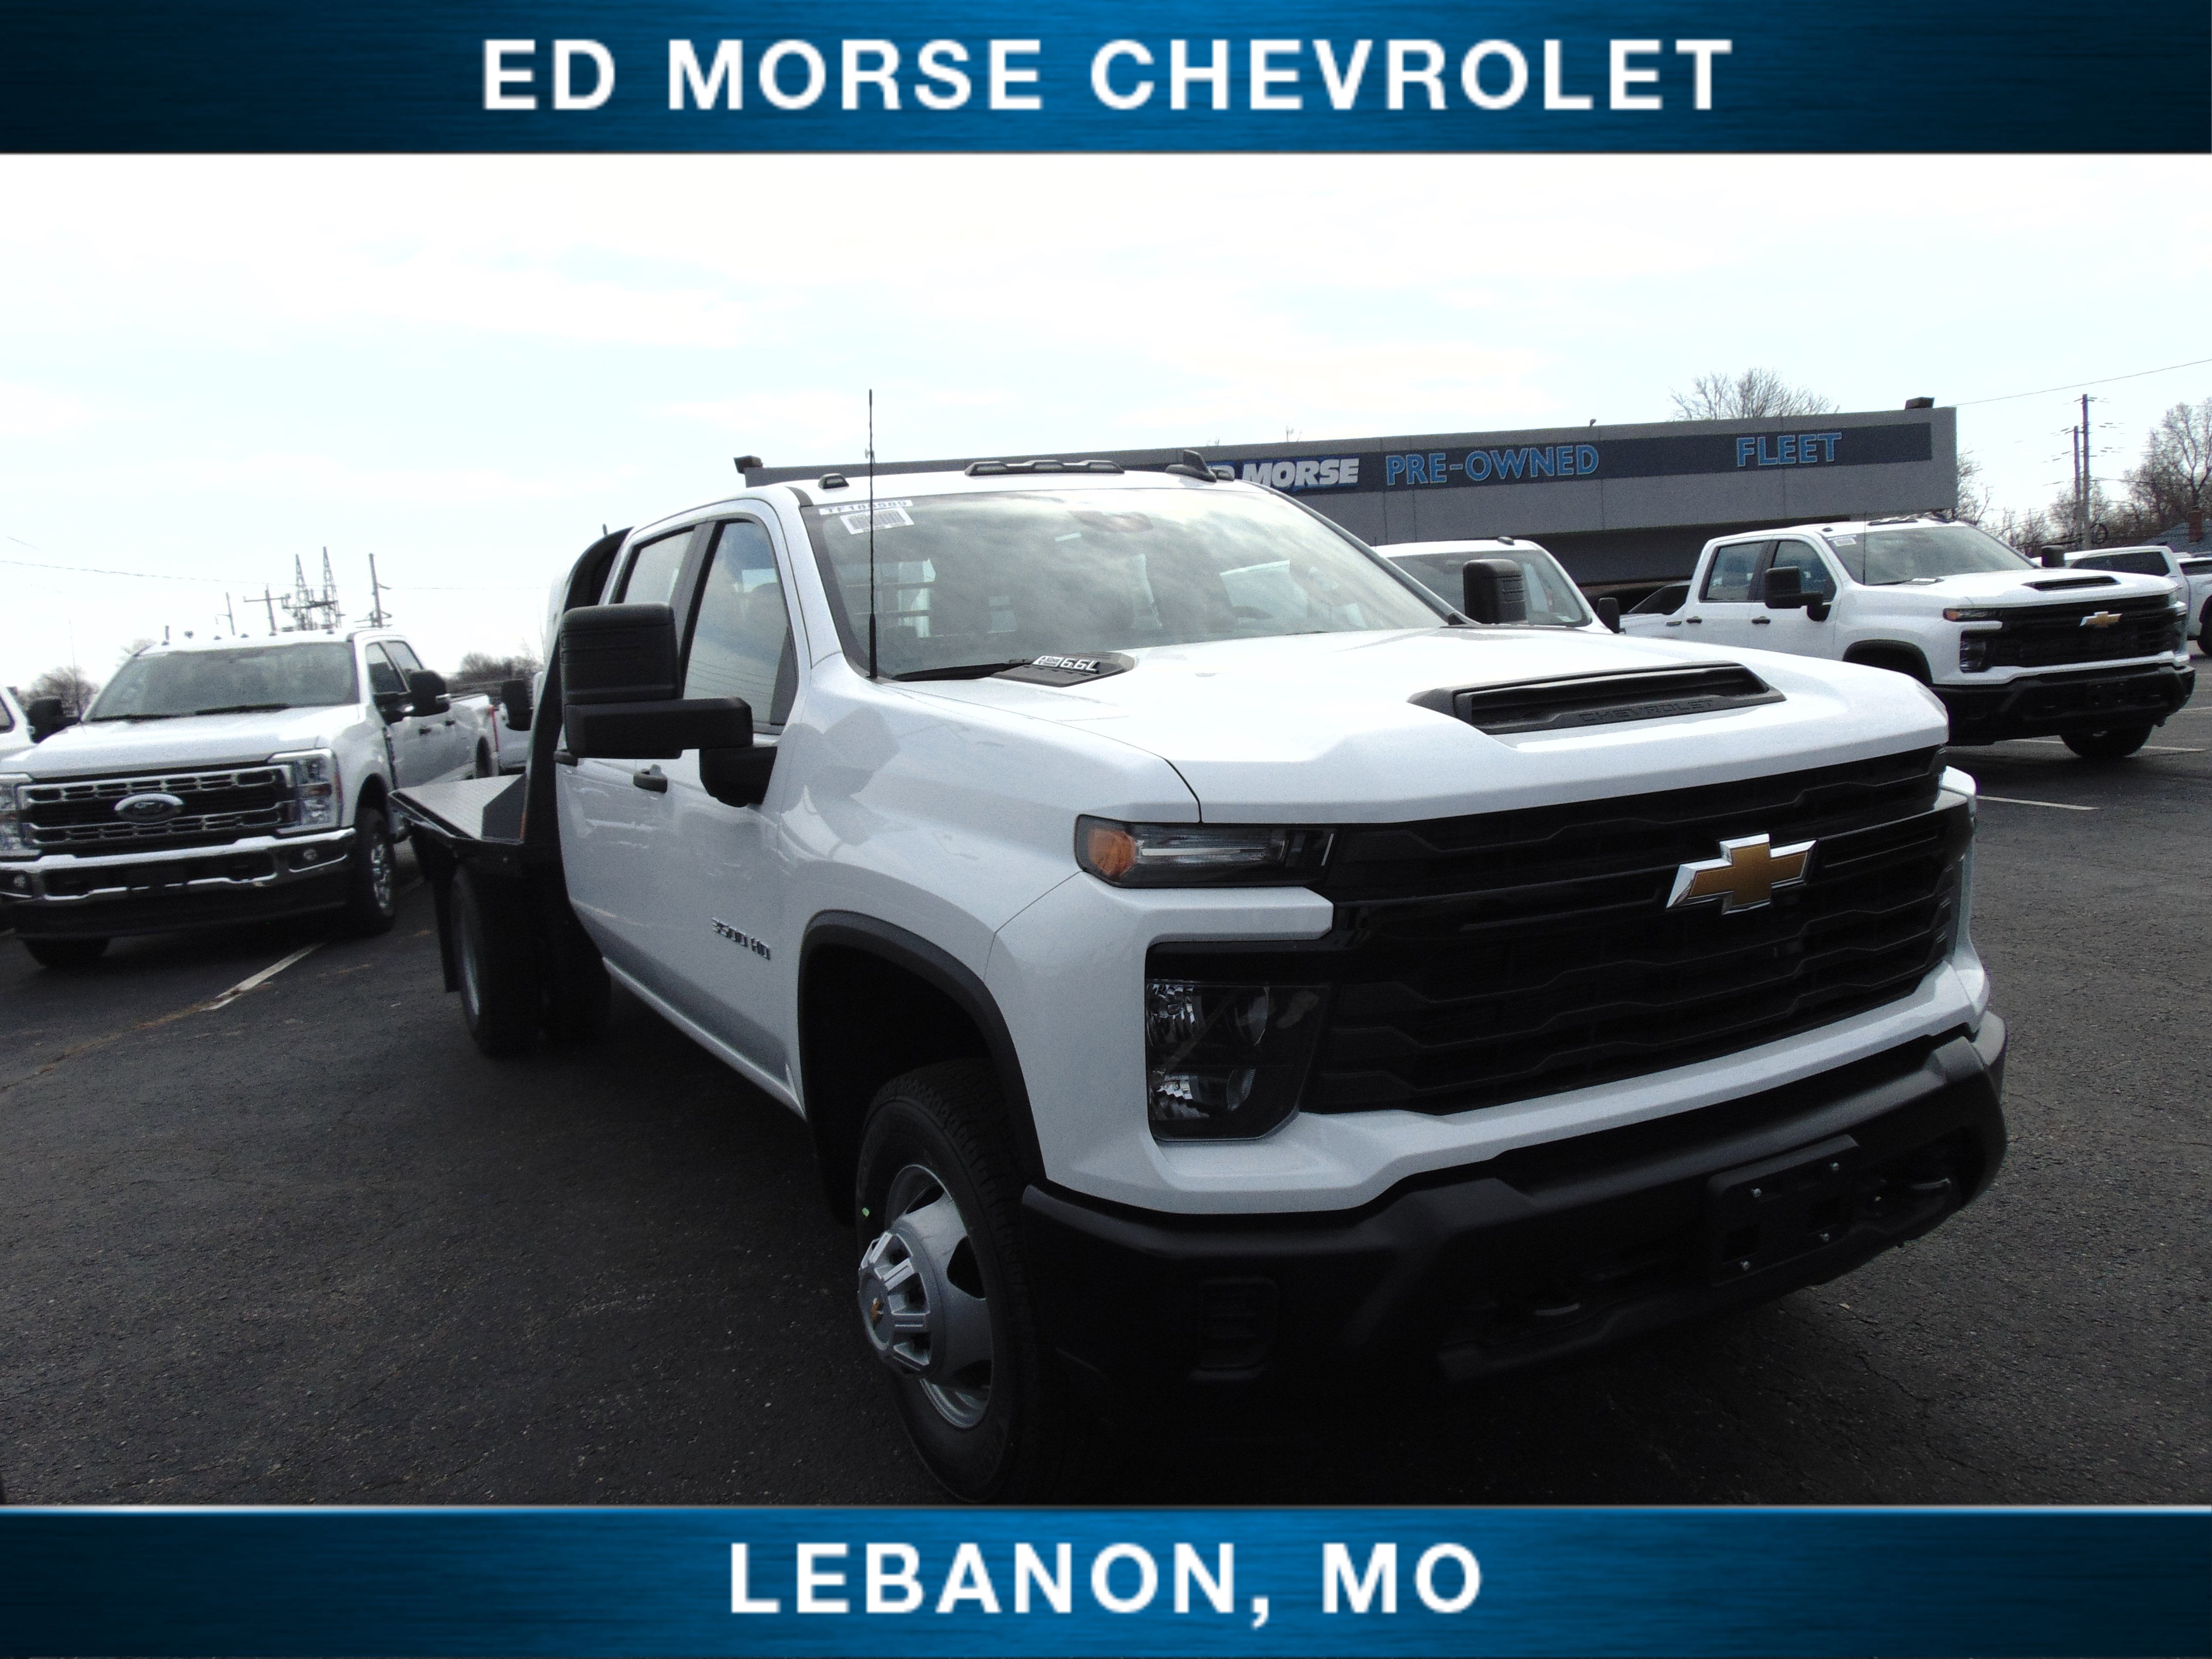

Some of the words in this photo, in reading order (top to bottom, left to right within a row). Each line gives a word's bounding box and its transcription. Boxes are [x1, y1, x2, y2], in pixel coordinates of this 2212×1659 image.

[1386, 444, 1599, 486] PRE-OWNED
[1737, 432, 1842, 467] FLEET
[1243, 458, 1360, 488] MORSE
[1579, 699, 1714, 722] CHEVROLET
